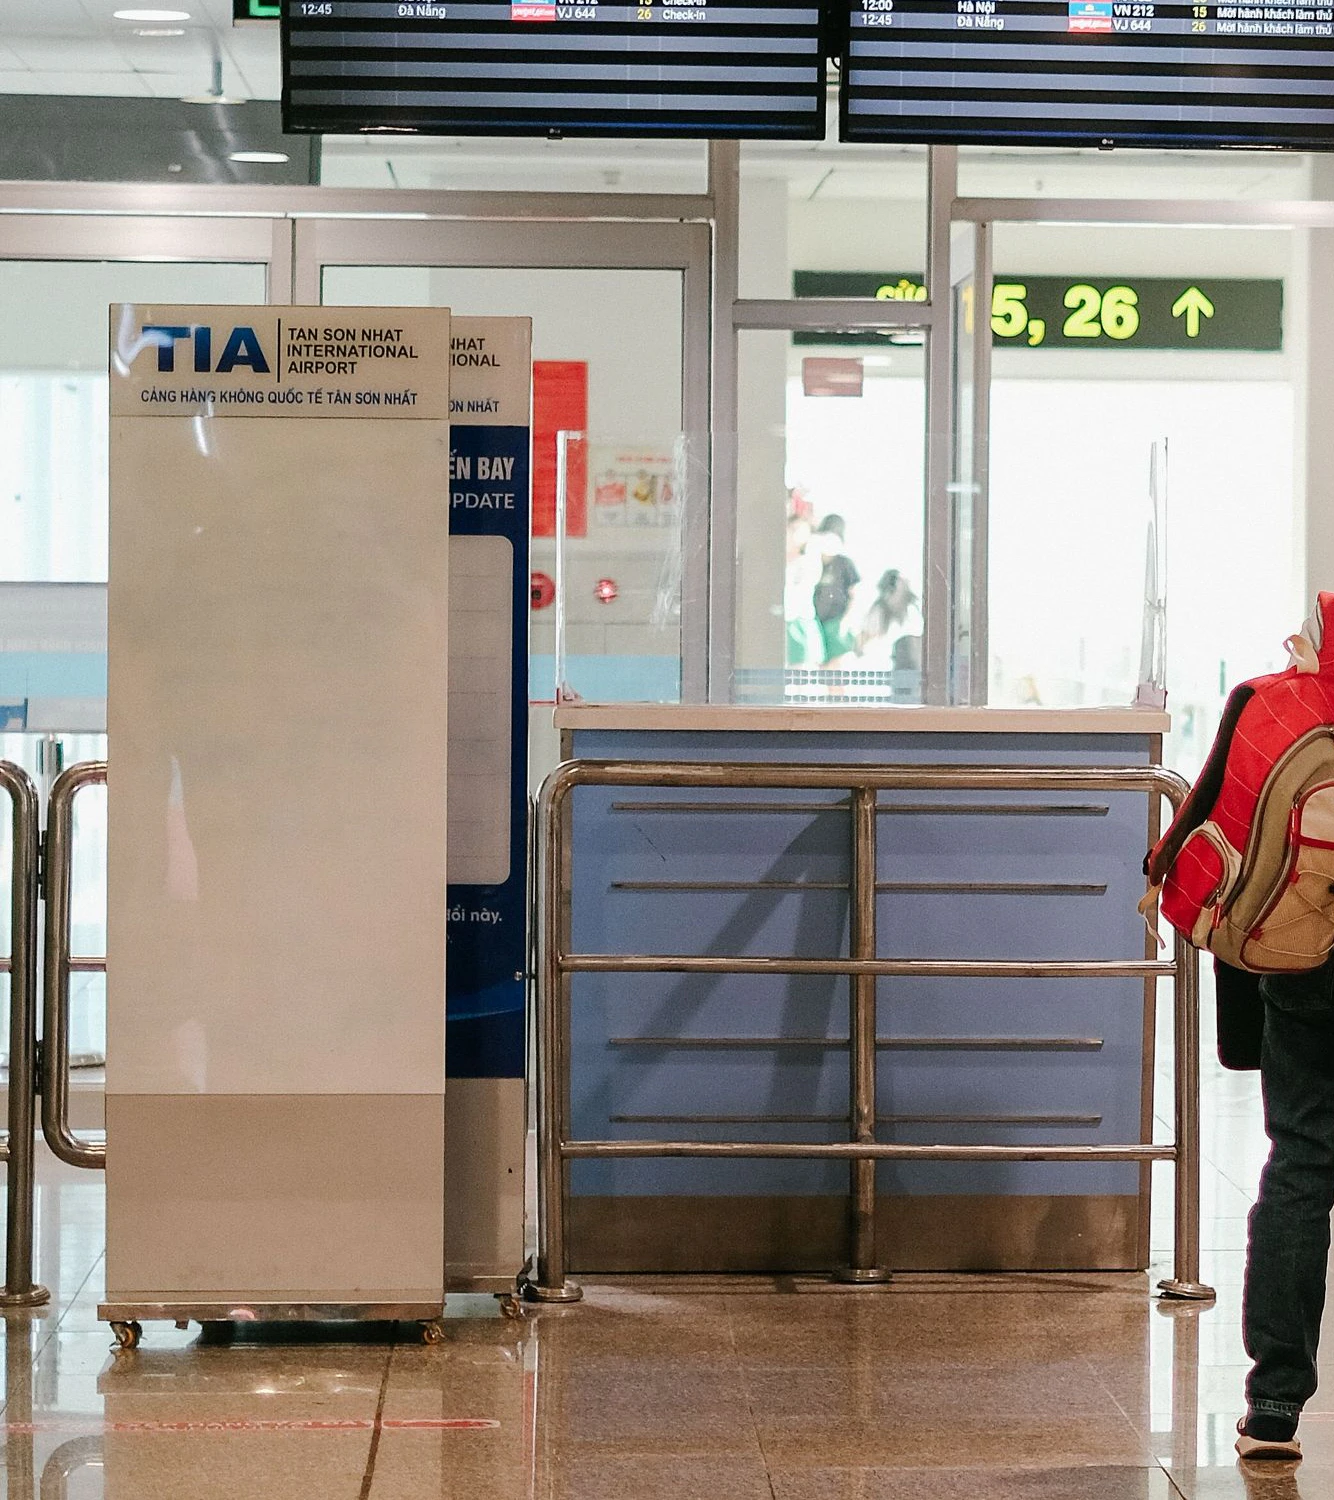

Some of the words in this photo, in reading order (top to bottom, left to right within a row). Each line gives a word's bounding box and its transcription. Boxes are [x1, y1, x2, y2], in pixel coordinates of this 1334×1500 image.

[301, 4, 332, 15] 12:45
[398, 4, 414, 16] Đà
[862, 0, 893, 11] 12:00
[957, 1, 972, 13] Hà
[1113, 5, 1130, 16] VN
[1132, 5, 1155, 17] 212
[557, 7, 573, 18] VJ
[574, 7, 596, 19] 644
[637, 8, 652, 20] 26
[1192, 6, 1207, 18] 15
[862, 14, 892, 26] 12:45
[957, 15, 973, 27] Đà
[1114, 20, 1129, 31] VJ
[1131, 20, 1152, 31] 644
[1191, 21, 1206, 32] 26
[1062, 283, 1140, 340] 26
[288, 328, 318, 341] TAN
[323, 328, 356, 341] SON
[361, 329, 403, 342] NHAT
[142, 326, 270, 372] TIA
[287, 344, 419, 359] INTERNATIONAL
[288, 361, 357, 374] AIRPORT
[141, 386, 177, 402] CẢNG
[180, 387, 216, 403] HÀNG
[220, 388, 264, 404] KHÔNG
[267, 387, 303, 405] QUỐC
[307, 388, 323, 404] TẾ
[326, 389, 352, 405] TÂN
[355, 390, 381, 405] SƠN
[384, 389, 418, 405] NHẤT
[467, 398, 500, 413] NHẤT
[477, 456, 515, 480] BAY
[449, 492, 515, 509] PDATE
[471, 907, 502, 925] này.
